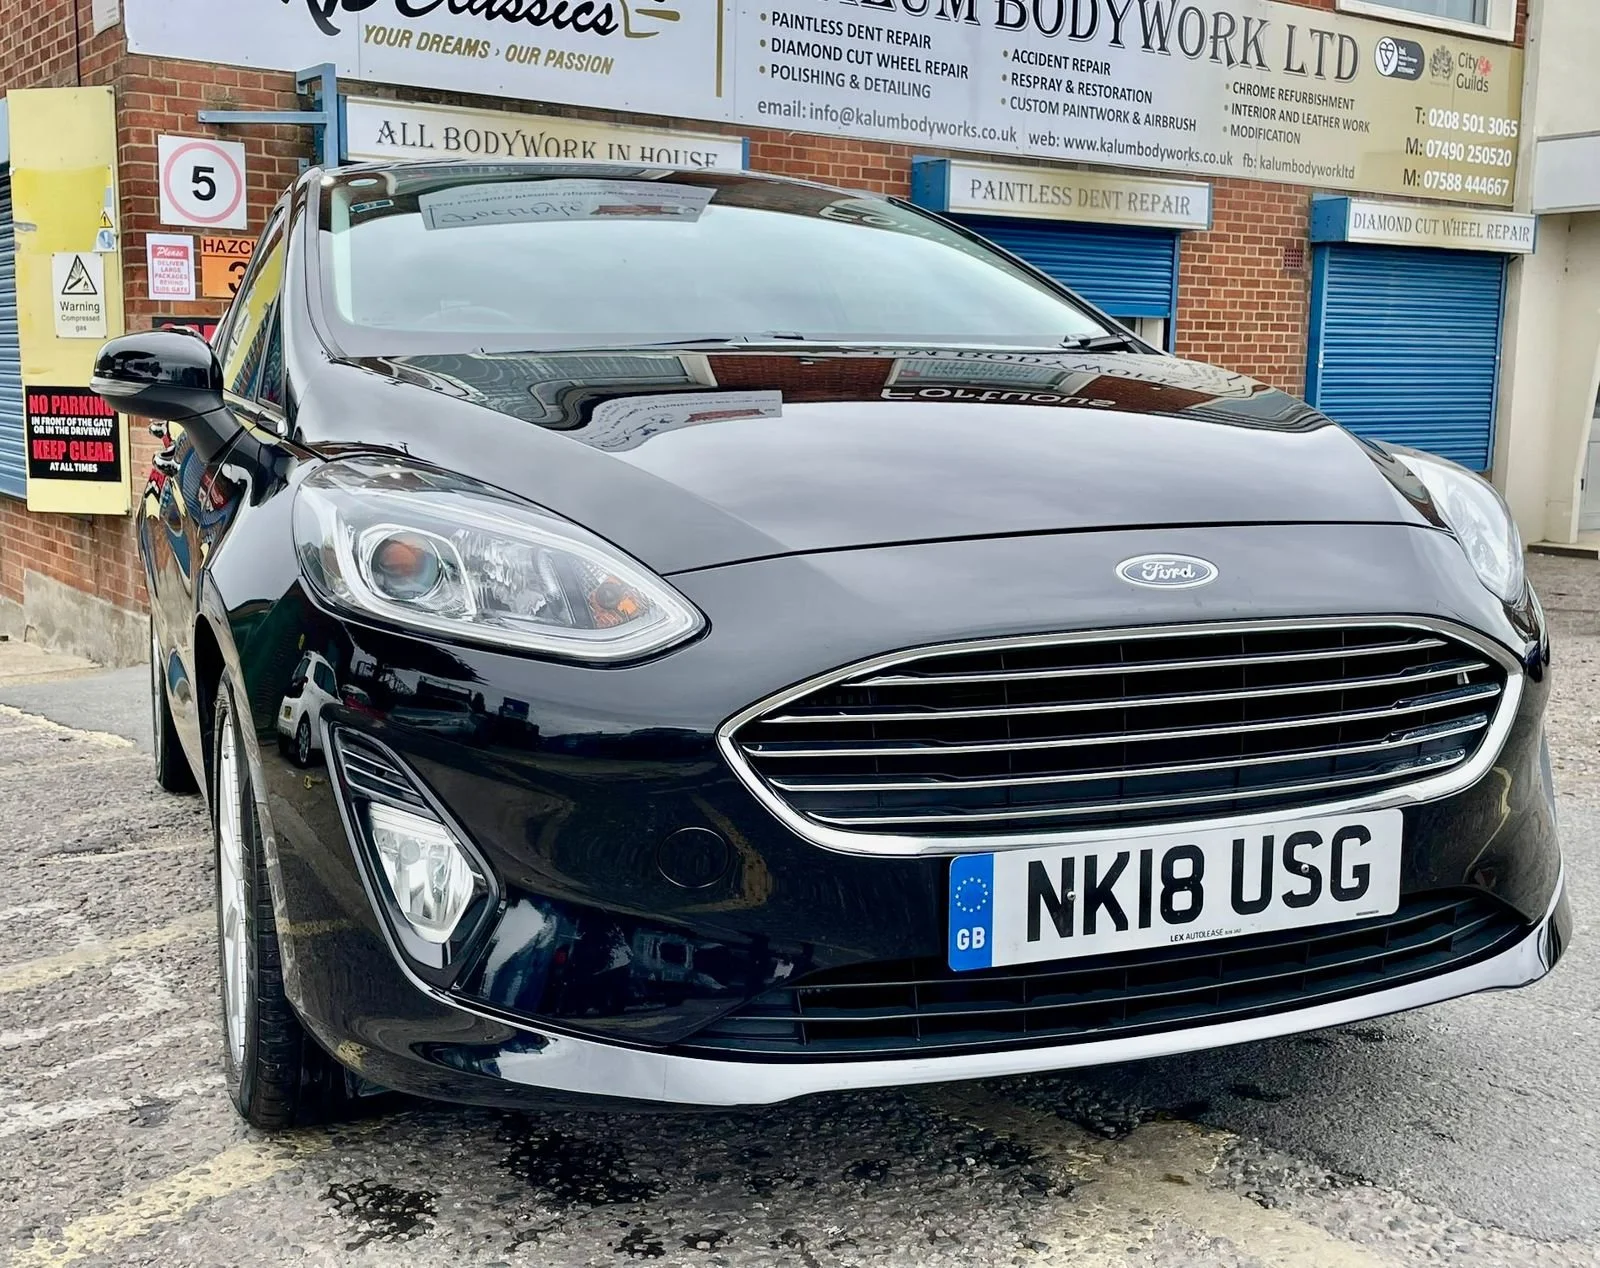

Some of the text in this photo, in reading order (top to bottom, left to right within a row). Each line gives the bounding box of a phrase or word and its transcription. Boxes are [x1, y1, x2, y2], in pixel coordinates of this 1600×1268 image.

[395, 0, 619, 36] assics
[772, 11, 843, 36] PAINTLESS
[847, 23, 882, 42] DENT
[886, 30, 932, 49] REPAIR
[364, 24, 614, 76] YOUR DREAMS OUR PASSION
[772, 38, 969, 80] DIAMOND CUT WHEEL REPAIR
[1012, 50, 1111, 76] ACCIDENT REPAIR
[1283, 24, 1359, 83] LTD
[1458, 52, 1479, 71] City
[771, 64, 931, 98] POLISHING & DETAILING
[1012, 73, 1153, 104] RESPRAY & RESTORATION
[1456, 73, 1489, 93] Guilds
[1233, 82, 1355, 110] CHROME REFURBISHMENT
[1010, 96, 1197, 132] CUSTOM PAINTWORK & AIRBRUSH
[1232, 103, 1370, 133] INTERIOR AND LEATHER WORK
[1415, 106, 1518, 138] T: 0208 501 3065
[376, 120, 434, 150] ALL
[444, 128, 597, 160] BODYWORK
[608, 143, 631, 161] IN
[758, 100, 1355, 179] email: info@kalumbodyworks.co.uk web: www.kalumbodyworks.co.uk fb: kalumbodyworkltd
[1230, 124, 1300, 144] MODIFICATION
[1405, 137, 1512, 167] M: 07490 250520
[192, 166, 216, 201] 5
[1403, 168, 1510, 196] M: 07588 444667
[970, 179, 1191, 216] PAINTLESS DENT REPAIR
[1353, 212, 1530, 242] DIAMOND CUT WHEEL REPAIR
[157, 246, 184, 257] Please
[60, 300, 100, 314] Warning
[61, 314, 100, 322] Compressed
[28, 394, 48, 414] NO
[32, 416, 113, 428] IN FRONT OF THE GATE
[34, 426, 111, 436] OR IN THE DRIVEWAY
[32, 440, 114, 462] KEEP CLEAR
[50, 462, 98, 472] AT ALL TIMES
[1142, 561, 1196, 581] Ford
[1027, 824, 1372, 943] NK18 USG
[956, 926, 985, 950] GB
[1170, 934, 1184, 942] LEX
[1186, 928, 1224, 940] AUTOLEASE
